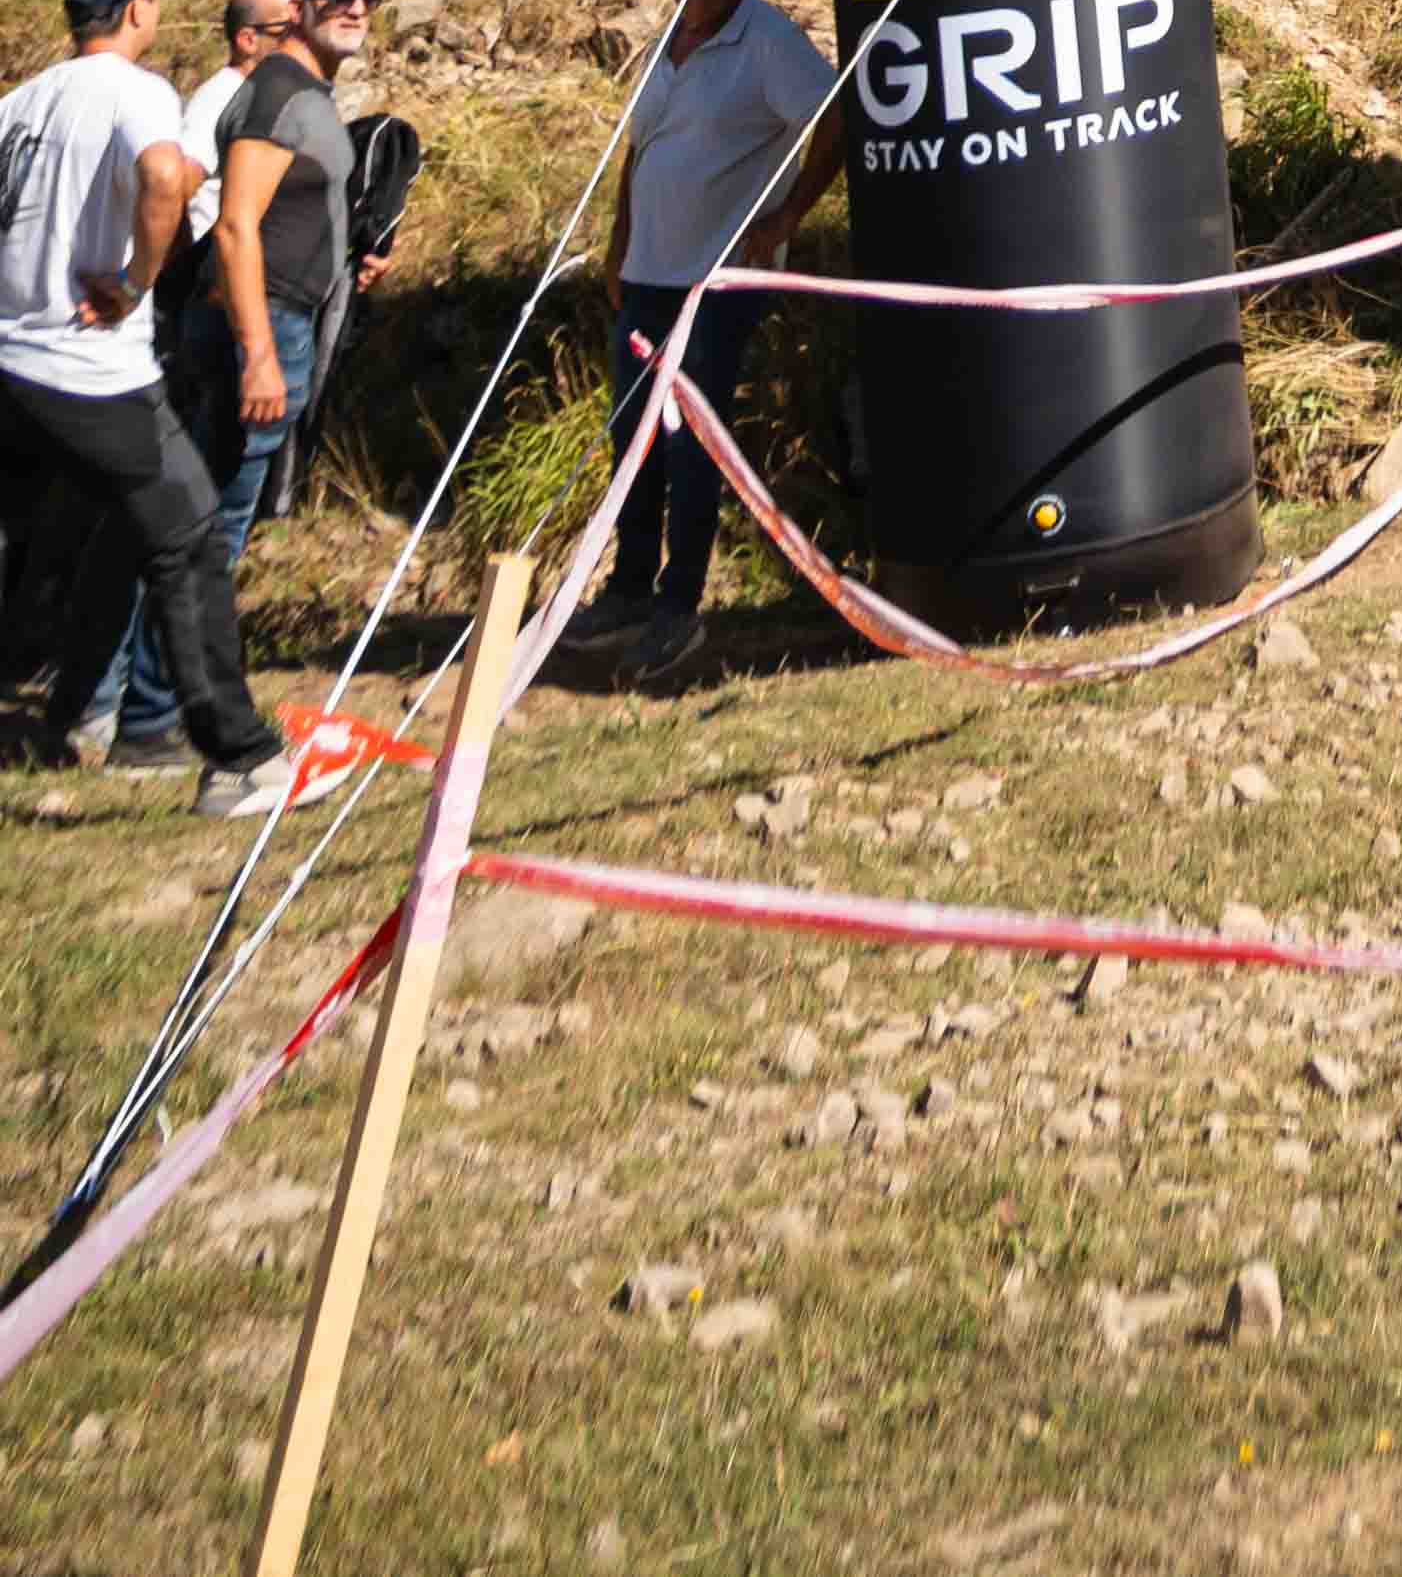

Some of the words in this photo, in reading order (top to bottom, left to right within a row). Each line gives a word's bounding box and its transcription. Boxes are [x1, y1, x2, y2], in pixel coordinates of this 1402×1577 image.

[864, 137, 944, 172] STAY
[961, 126, 1029, 165] ON
[1045, 91, 1182, 153] TRACK
